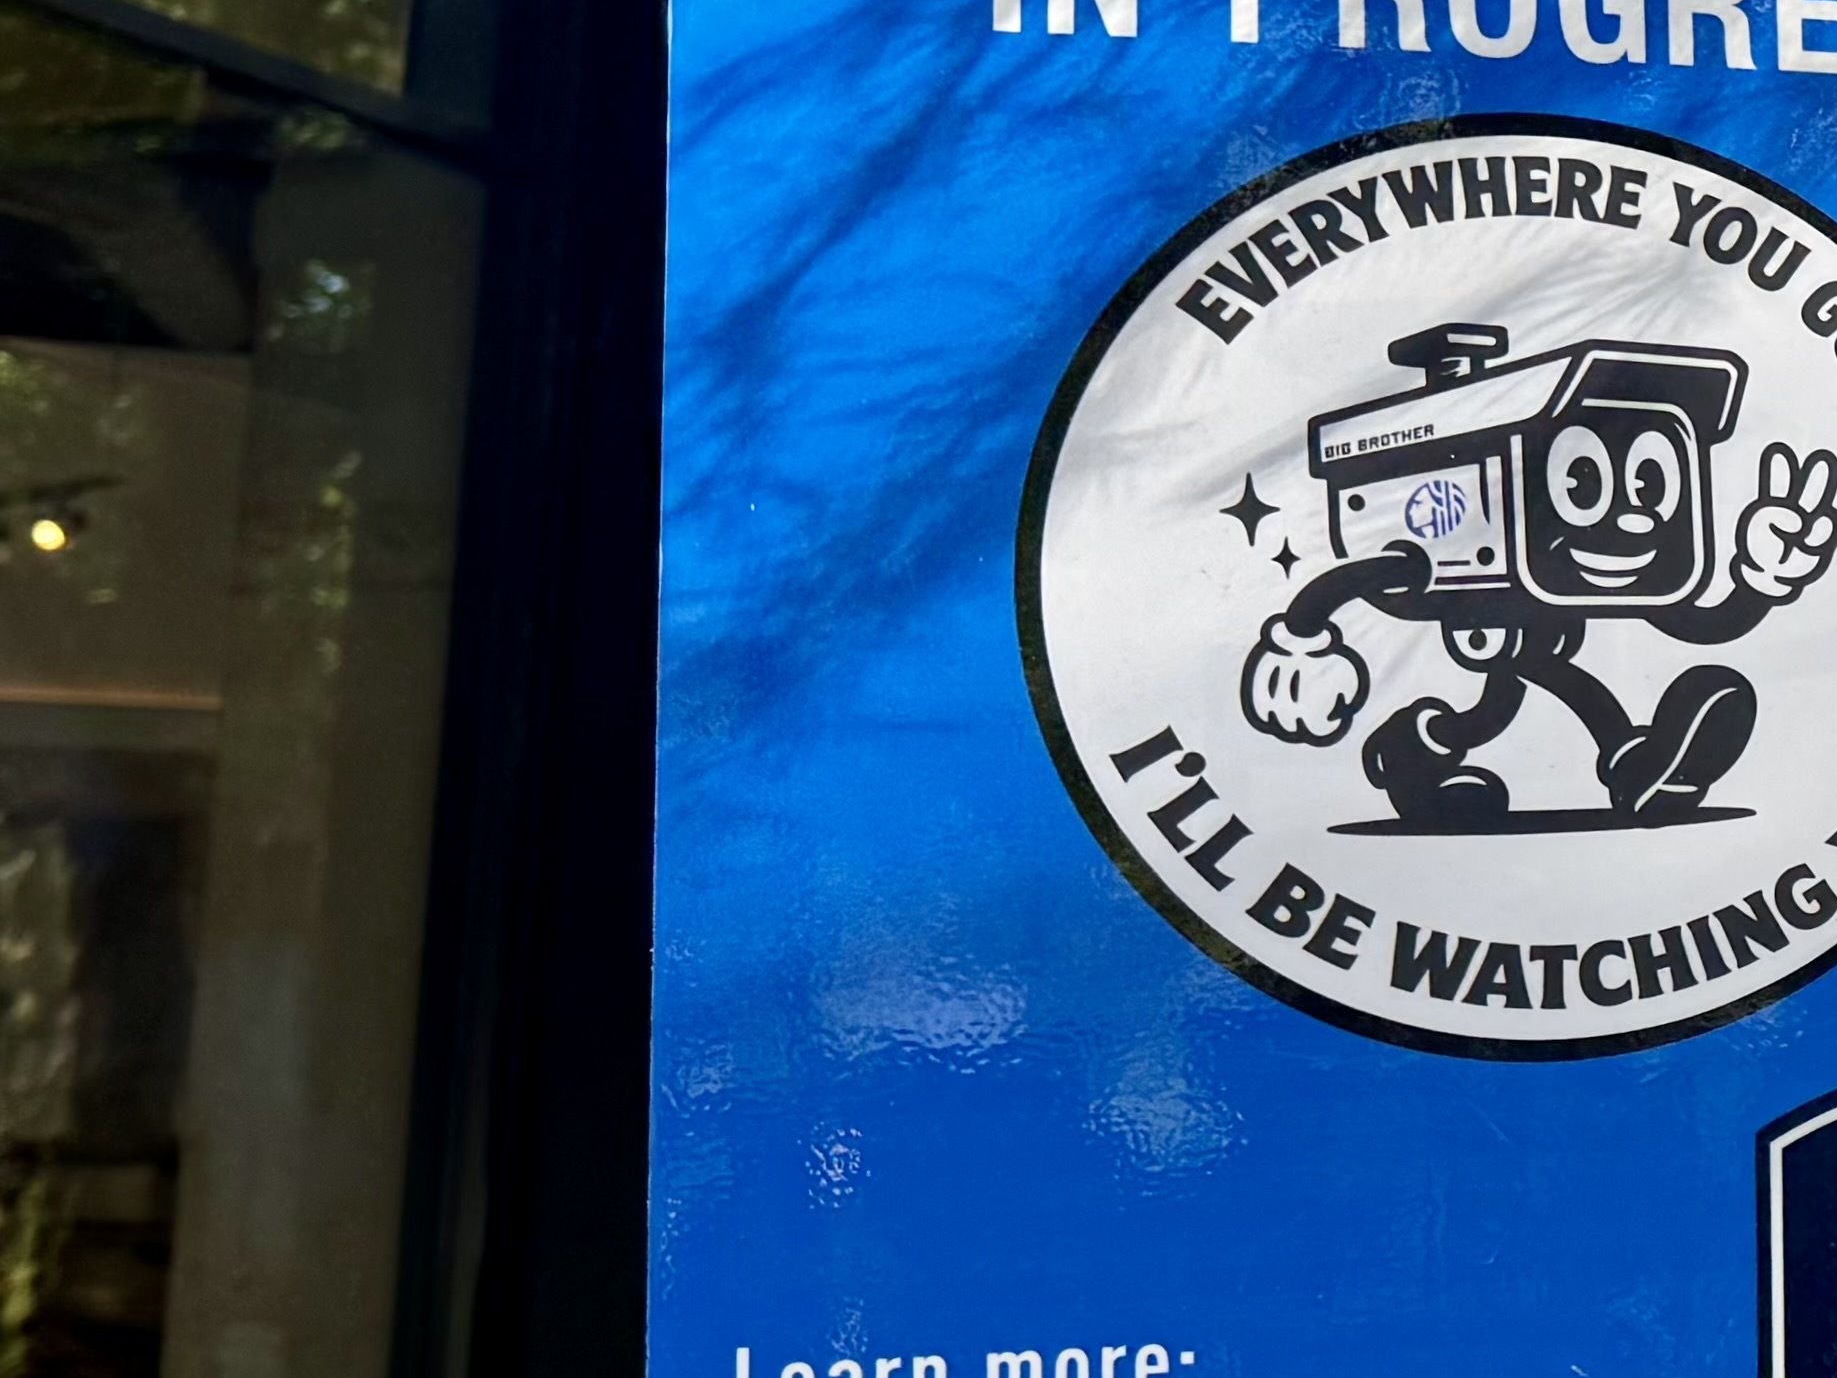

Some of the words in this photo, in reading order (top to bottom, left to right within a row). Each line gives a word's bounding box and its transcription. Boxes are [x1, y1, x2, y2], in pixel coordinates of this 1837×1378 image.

[1174, 155, 1648, 345] EVERYWHERE
[1668, 183, 1811, 292] YOU
[1323, 441, 1352, 460] BIG
[1357, 423, 1436, 452] BROTHER
[1109, 724, 1258, 893] I'LL
[1245, 862, 1376, 971] BE
